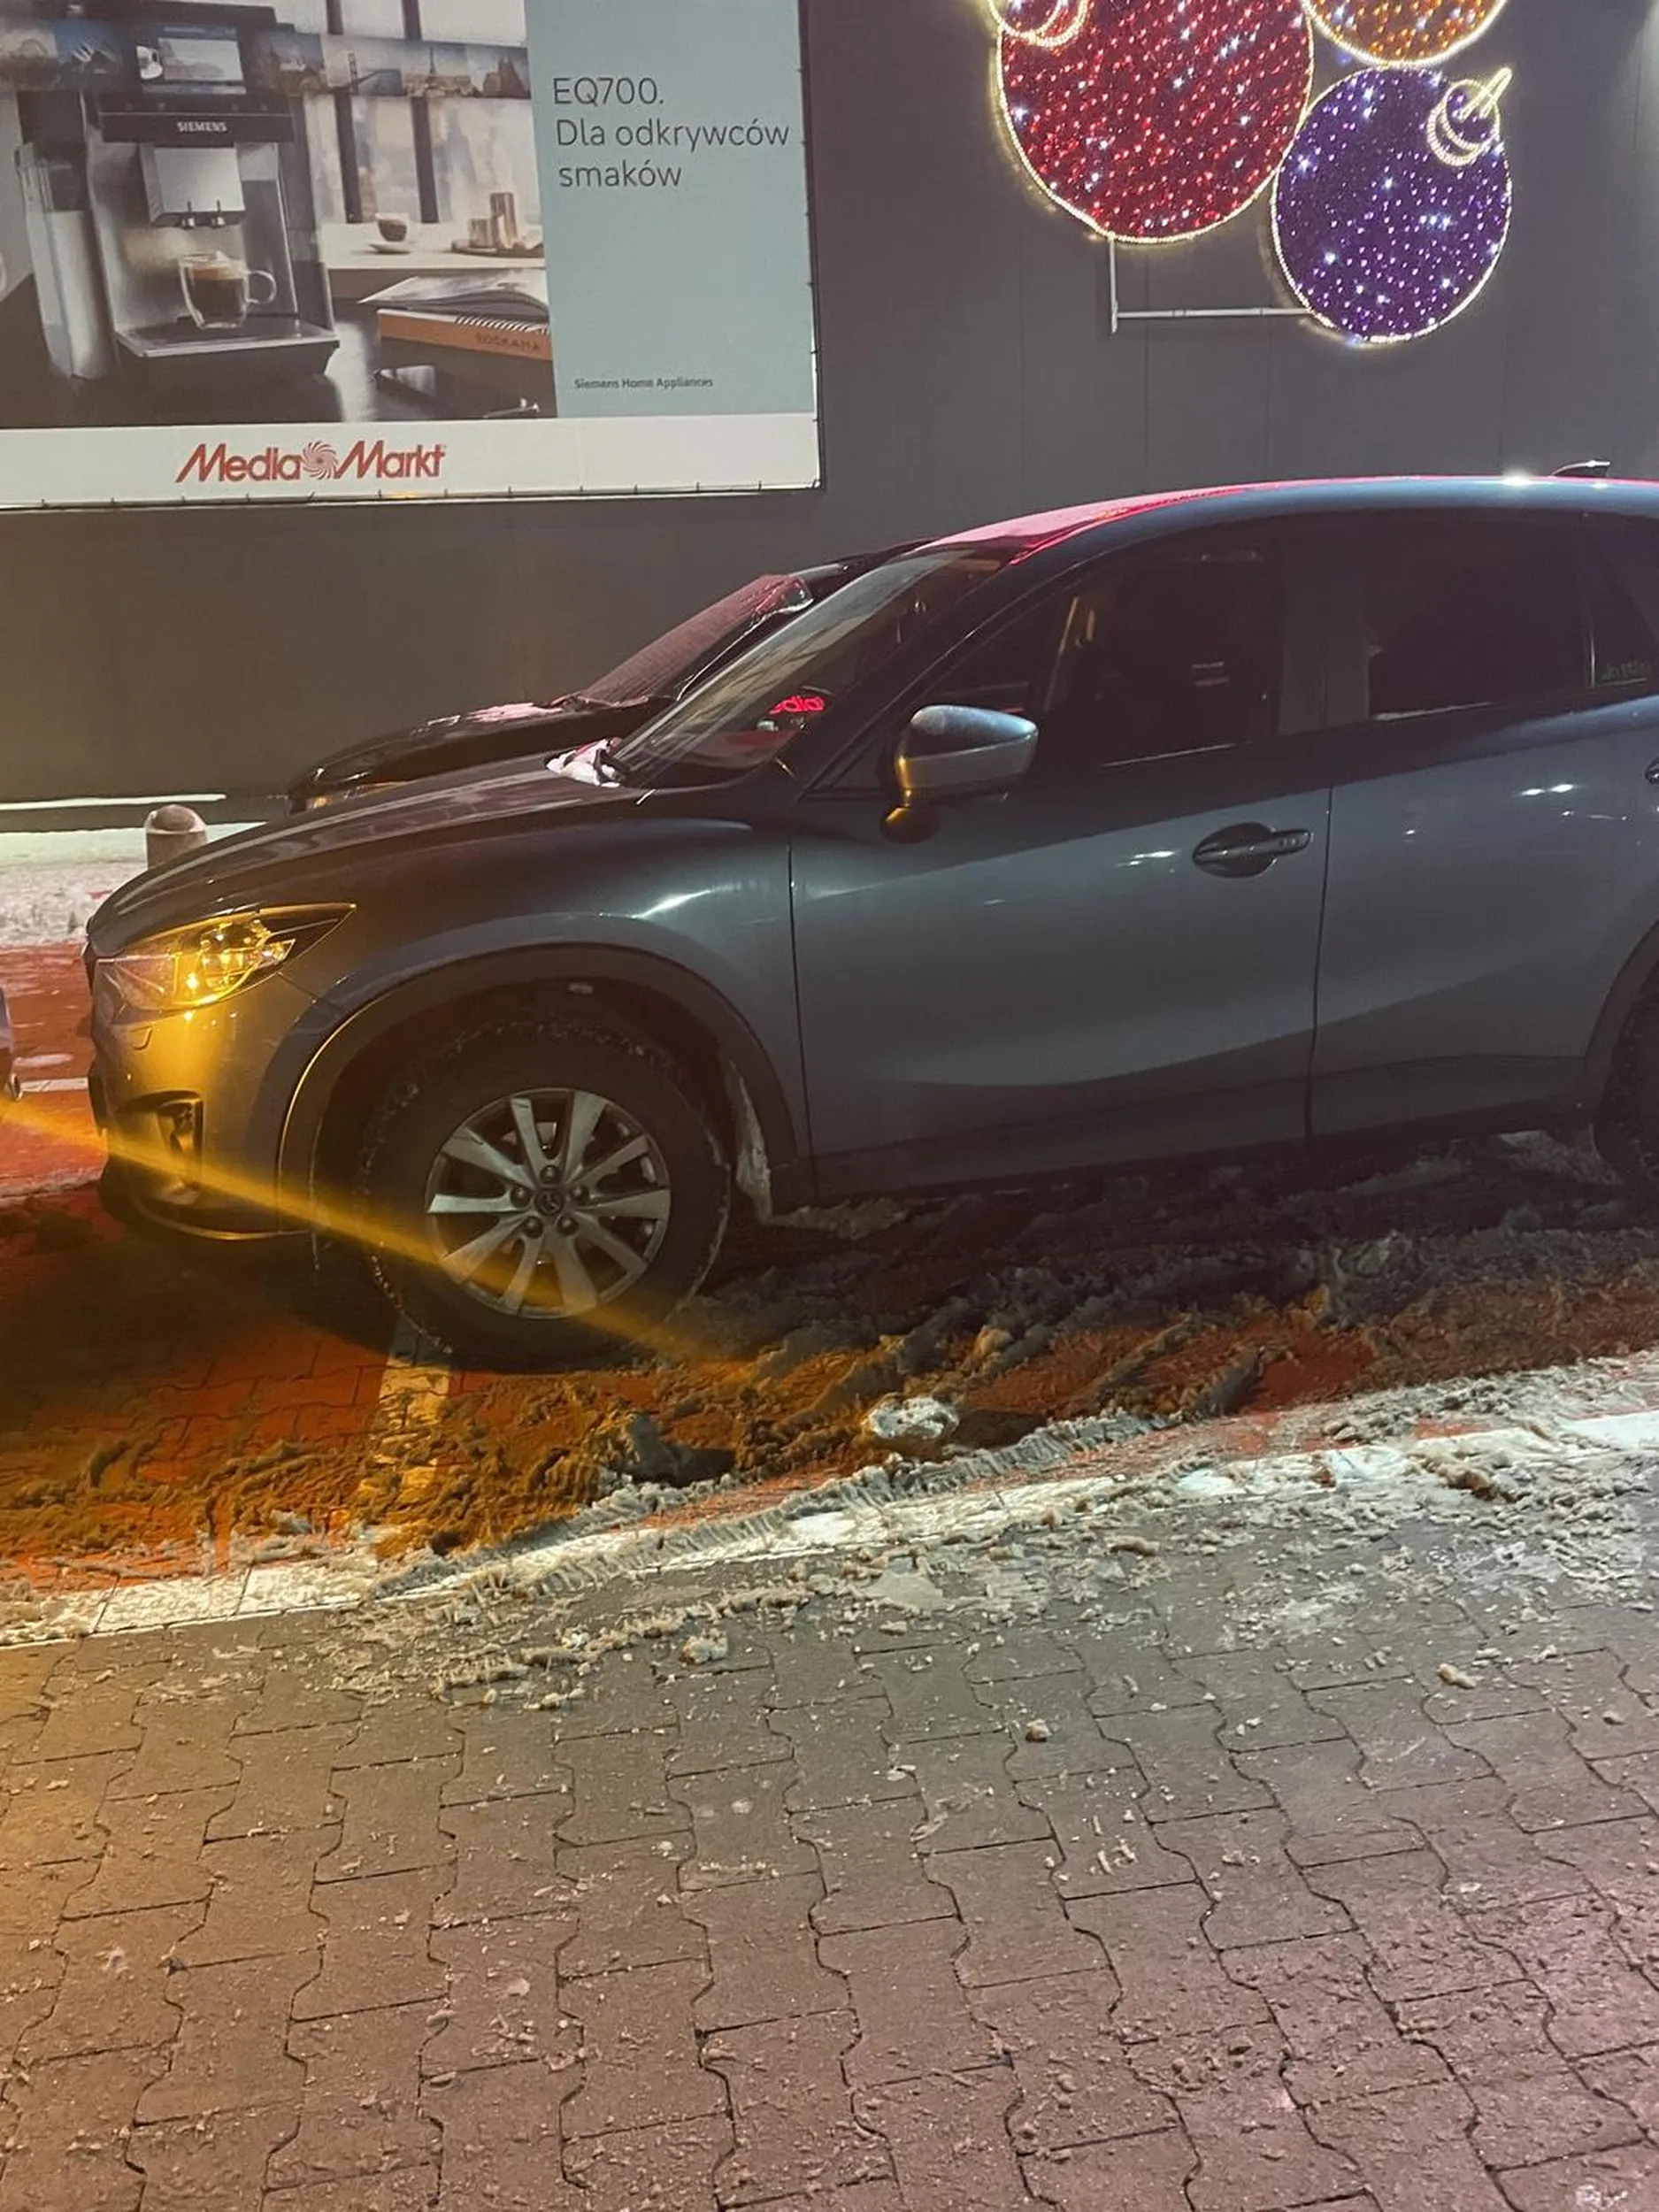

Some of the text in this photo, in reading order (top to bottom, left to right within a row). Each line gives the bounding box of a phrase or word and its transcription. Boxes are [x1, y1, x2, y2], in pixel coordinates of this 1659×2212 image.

[553, 77, 664, 106] EQ700.
[177, 121, 227, 132] SIEMENS
[557, 118, 789, 152] Dla odkrywców
[559, 159, 682, 188] smaków
[574, 378, 713, 389] Siemens Home Appliances
